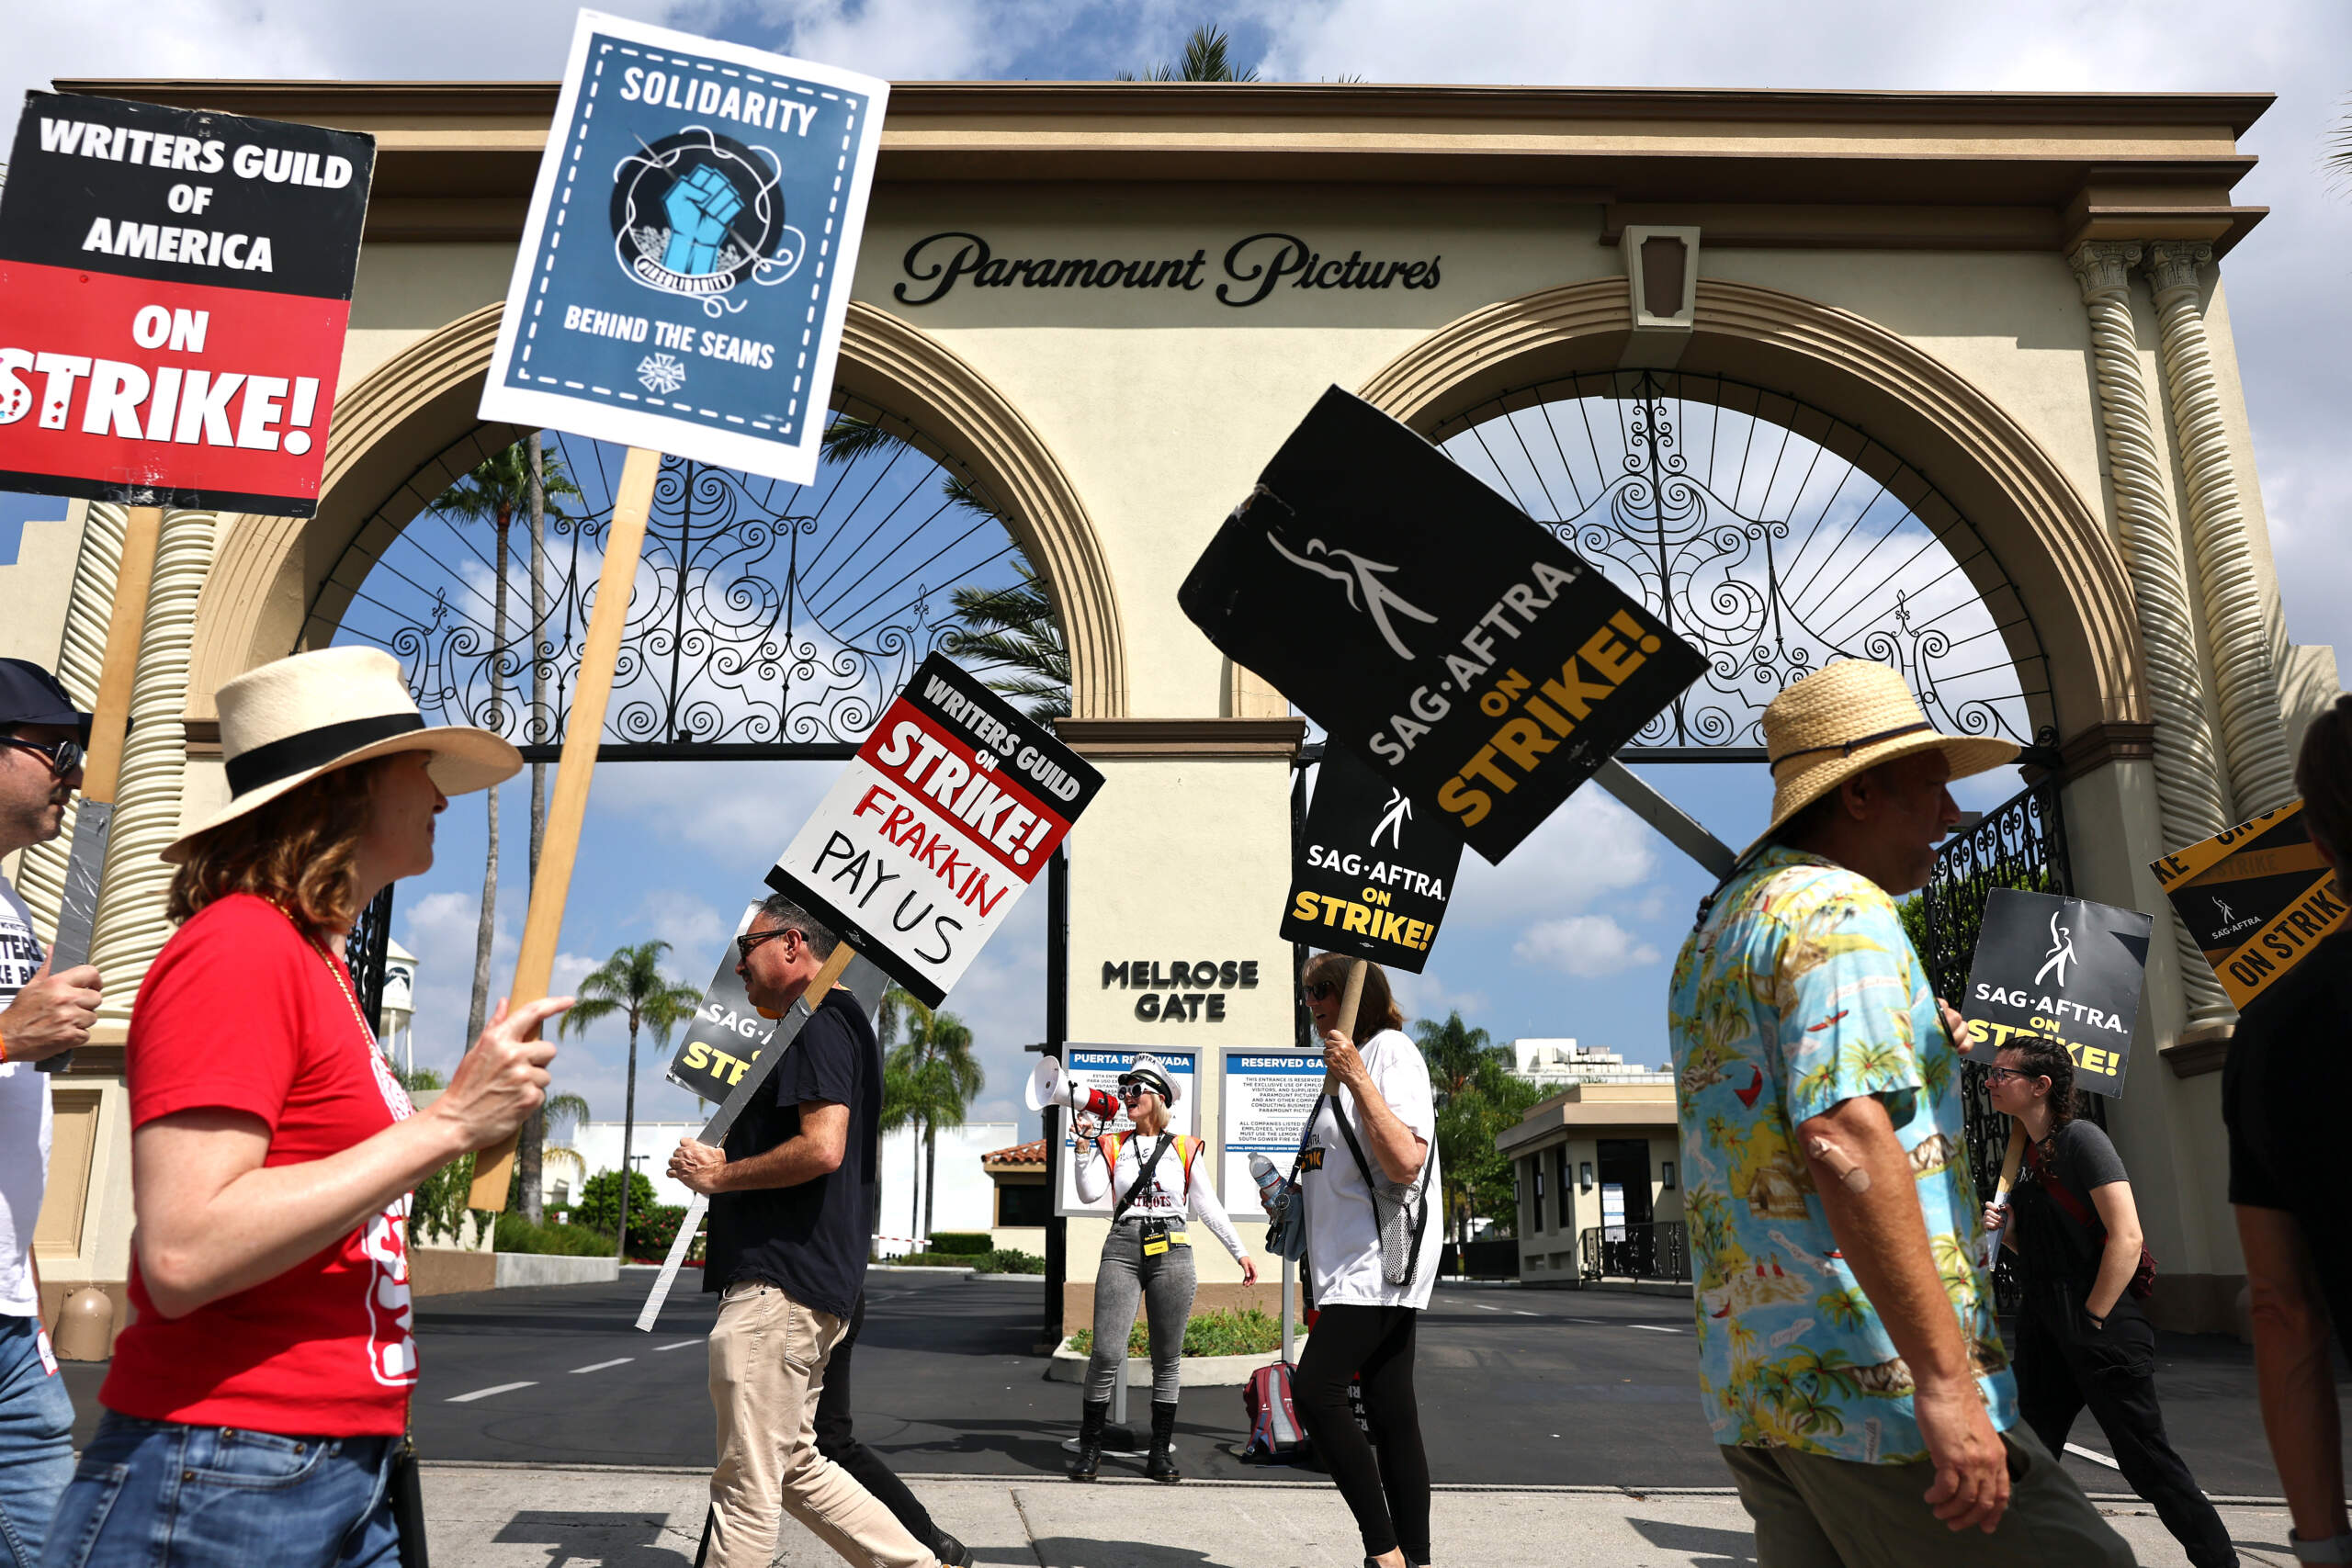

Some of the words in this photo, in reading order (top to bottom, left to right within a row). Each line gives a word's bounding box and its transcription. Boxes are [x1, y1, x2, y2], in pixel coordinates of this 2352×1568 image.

[619, 66, 818, 137] SOLIDARITY
[40, 118, 225, 174] WRITERS
[232, 144, 353, 189] GUILD
[167, 184, 213, 215] OF
[82, 217, 273, 273] AMERICA
[893, 231, 1205, 306] Paramount
[1216, 232, 1442, 308] Pictures
[132, 305, 209, 353] ON
[563, 304, 649, 343] BEHIND
[655, 321, 696, 352] THE
[699, 331, 775, 369] SEAMS
[0, 347, 320, 456] STRIKE!
[1437, 609, 1661, 827] STRIKE!
[1479, 669, 1531, 716] ON
[923, 673, 1021, 757] WRITERS
[1016, 747, 1080, 802] GUILD
[975, 749, 1000, 773] ON
[876, 721, 1053, 866] STRIKE!
[854, 784, 1009, 918] FRAKKIN
[812, 830, 900, 908] PAY
[892, 890, 963, 964] US
[1292, 891, 1434, 952] STRIKE!
[1362, 887, 1391, 908] ON
[1102, 961, 1258, 988] MELROSE
[2230, 950, 2278, 987] ON
[1136, 994, 1226, 1021] GATE
[2030, 1016, 2061, 1033] ON
[1074, 1054, 1119, 1065] PUERTA
[1241, 1058, 1304, 1067] RESERVED
